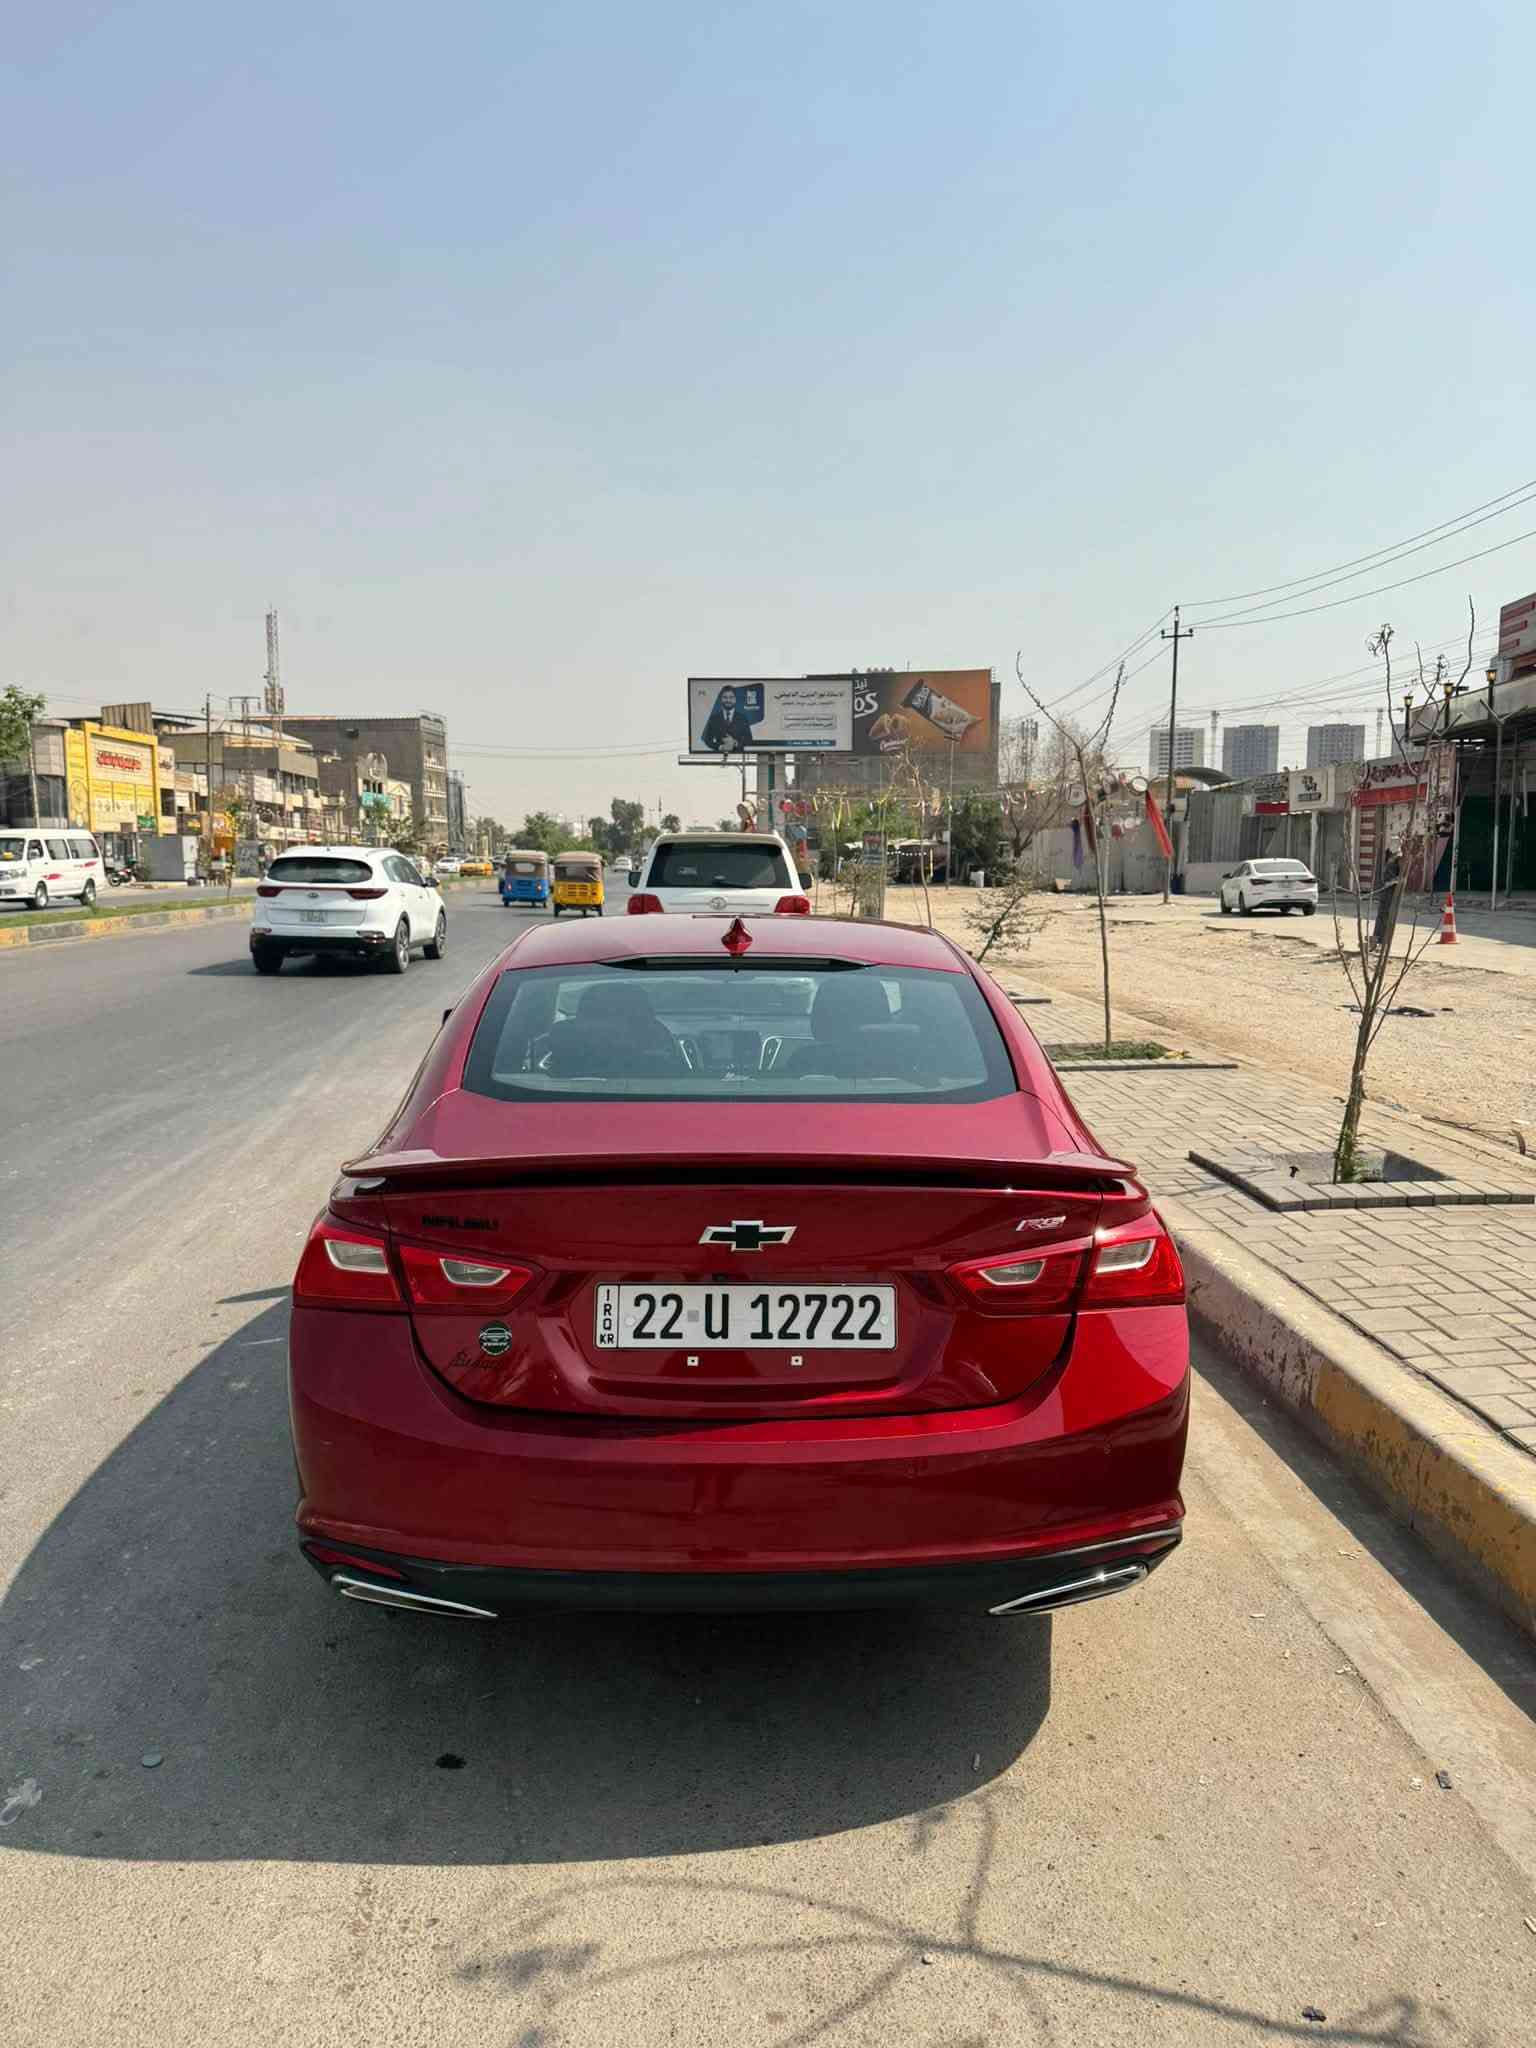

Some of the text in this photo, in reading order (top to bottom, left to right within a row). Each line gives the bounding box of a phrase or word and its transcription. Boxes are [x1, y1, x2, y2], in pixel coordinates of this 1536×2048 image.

[632, 1293, 882, 1341] 22 U 12722
[599, 1333, 615, 1345] KR
